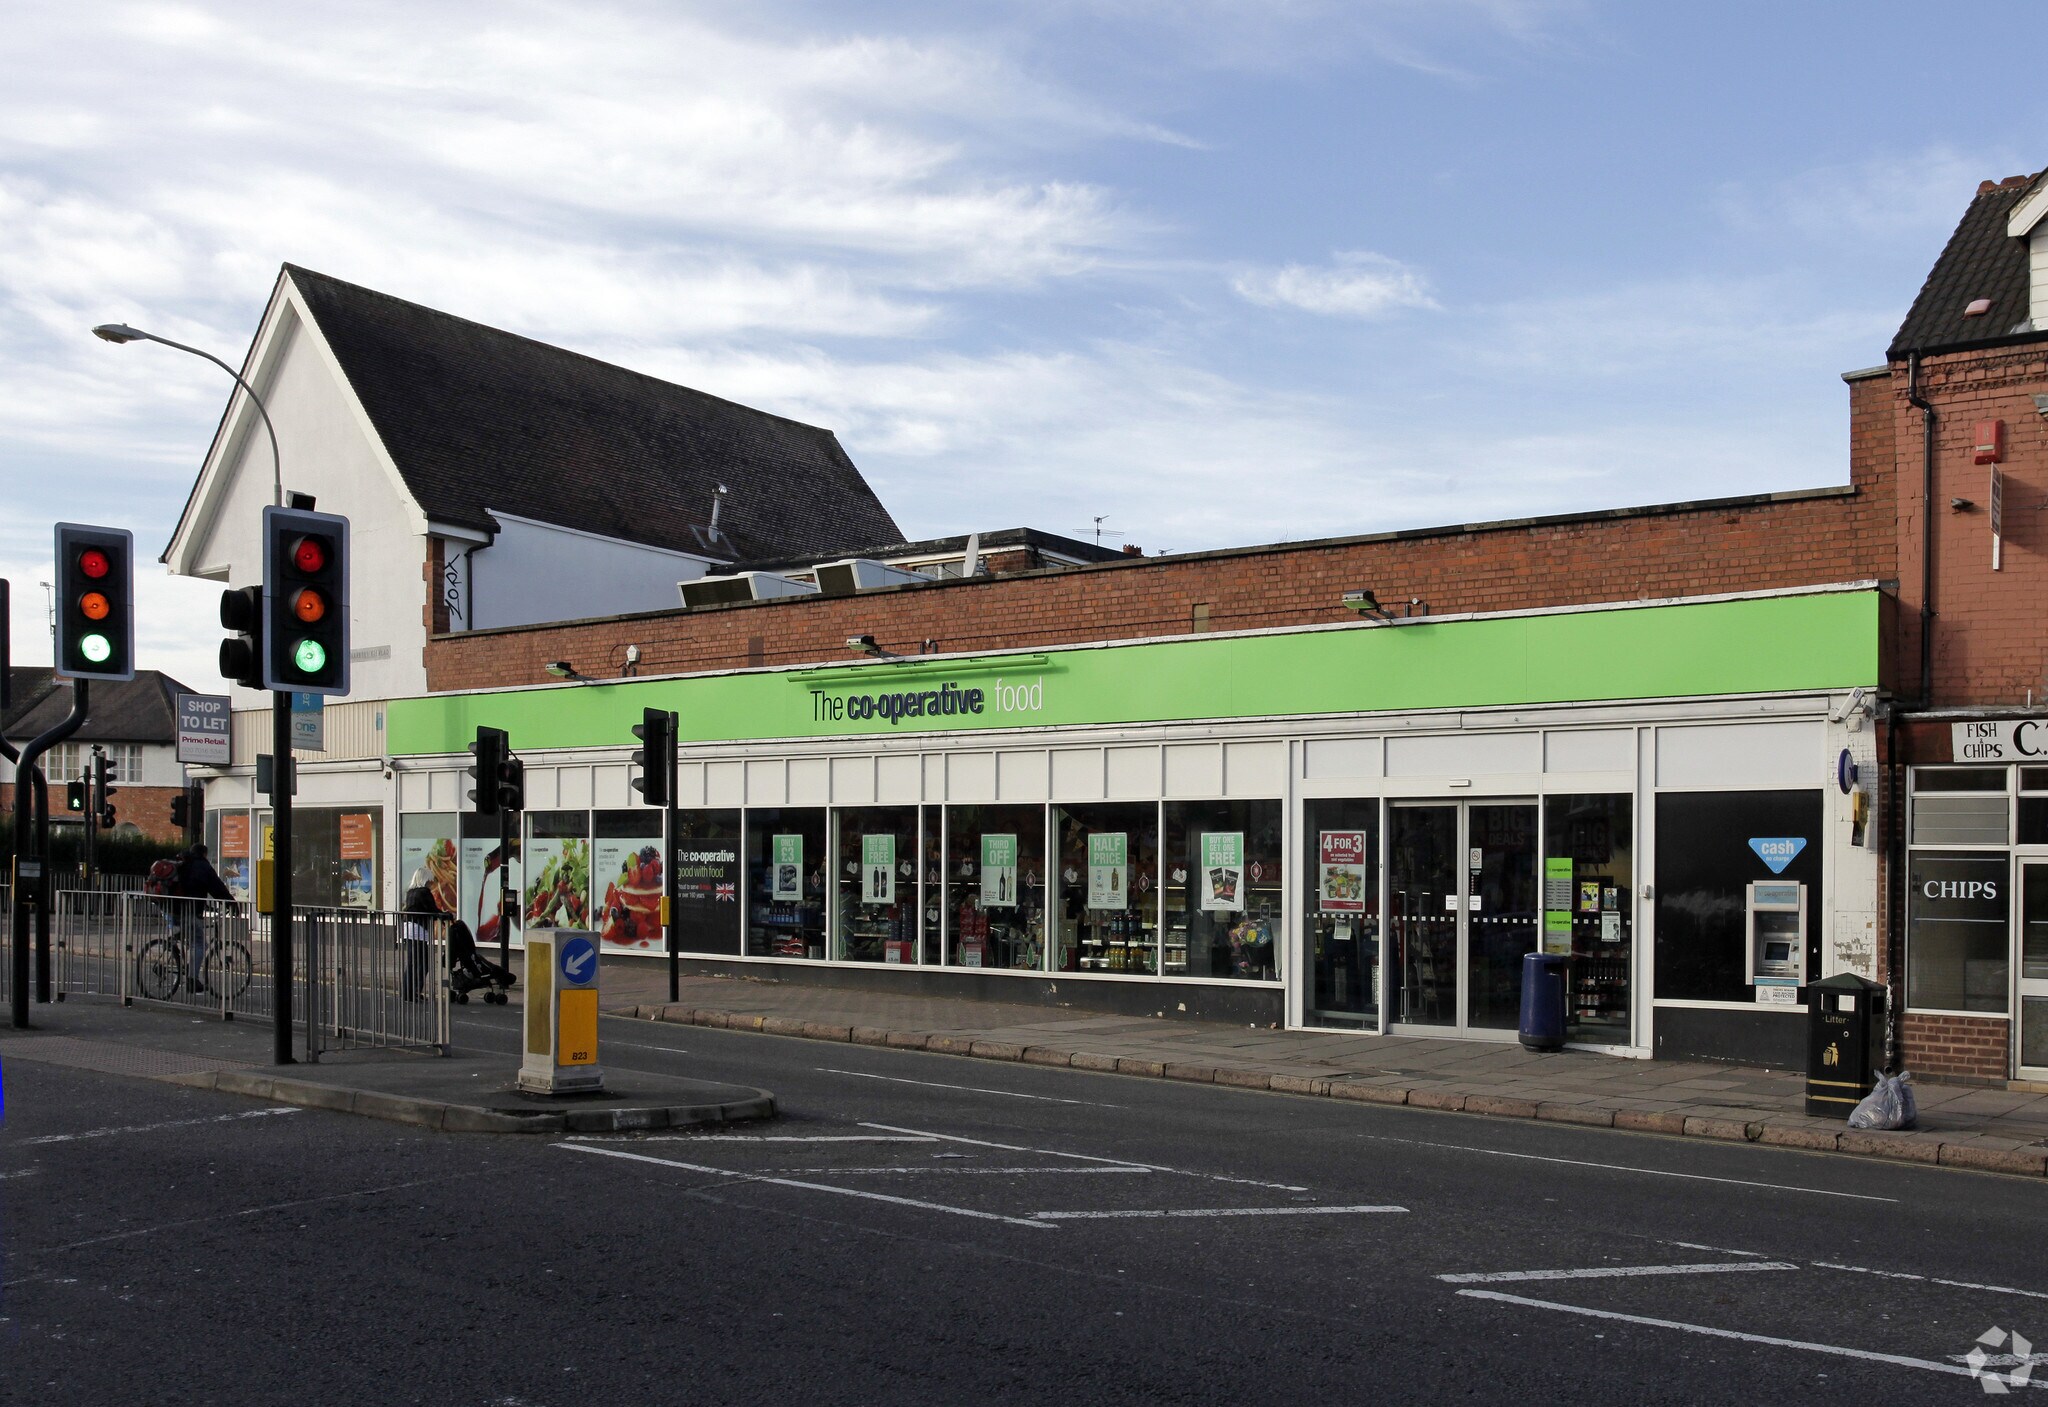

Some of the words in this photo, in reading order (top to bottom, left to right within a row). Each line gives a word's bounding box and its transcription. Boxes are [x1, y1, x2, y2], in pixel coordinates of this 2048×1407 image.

[188, 700, 221, 713] SHOP
[302, 692, 311, 707] er
[810, 690, 843, 721] The
[847, 682, 984, 726] co-operative
[994, 675, 1043, 713] food
[181, 716, 200, 729] TO
[203, 718, 227, 730] LET
[1967, 723, 1997, 738] FISH
[182, 736, 204, 744] Prime
[2013, 721, 2048, 756] C.
[1963, 743, 2003, 758] CHIPS
[781, 838, 795, 847] ONLY
[989, 840, 1009, 849] THIRD
[1094, 837, 1121, 851] HALF
[1209, 836, 1222, 844] BUY
[1223, 836, 1235, 844] ONE
[1323, 834, 1333, 852] 4
[1334, 838, 1352, 849] FOR
[1353, 834, 1363, 853] 3
[1761, 839, 1795, 855] cash
[678, 849, 689, 861] The
[690, 850, 735, 864] co-operative
[781, 847, 795, 862] £3
[869, 852, 889, 863] FREE
[989, 850, 1010, 865] OFF
[1094, 852, 1121, 864] PRICE
[1209, 852, 1236, 865] FREE
[678, 866, 693, 879] good
[694, 866, 708, 877] with
[709, 866, 724, 878] food
[1923, 880, 1997, 900] CHIPS
